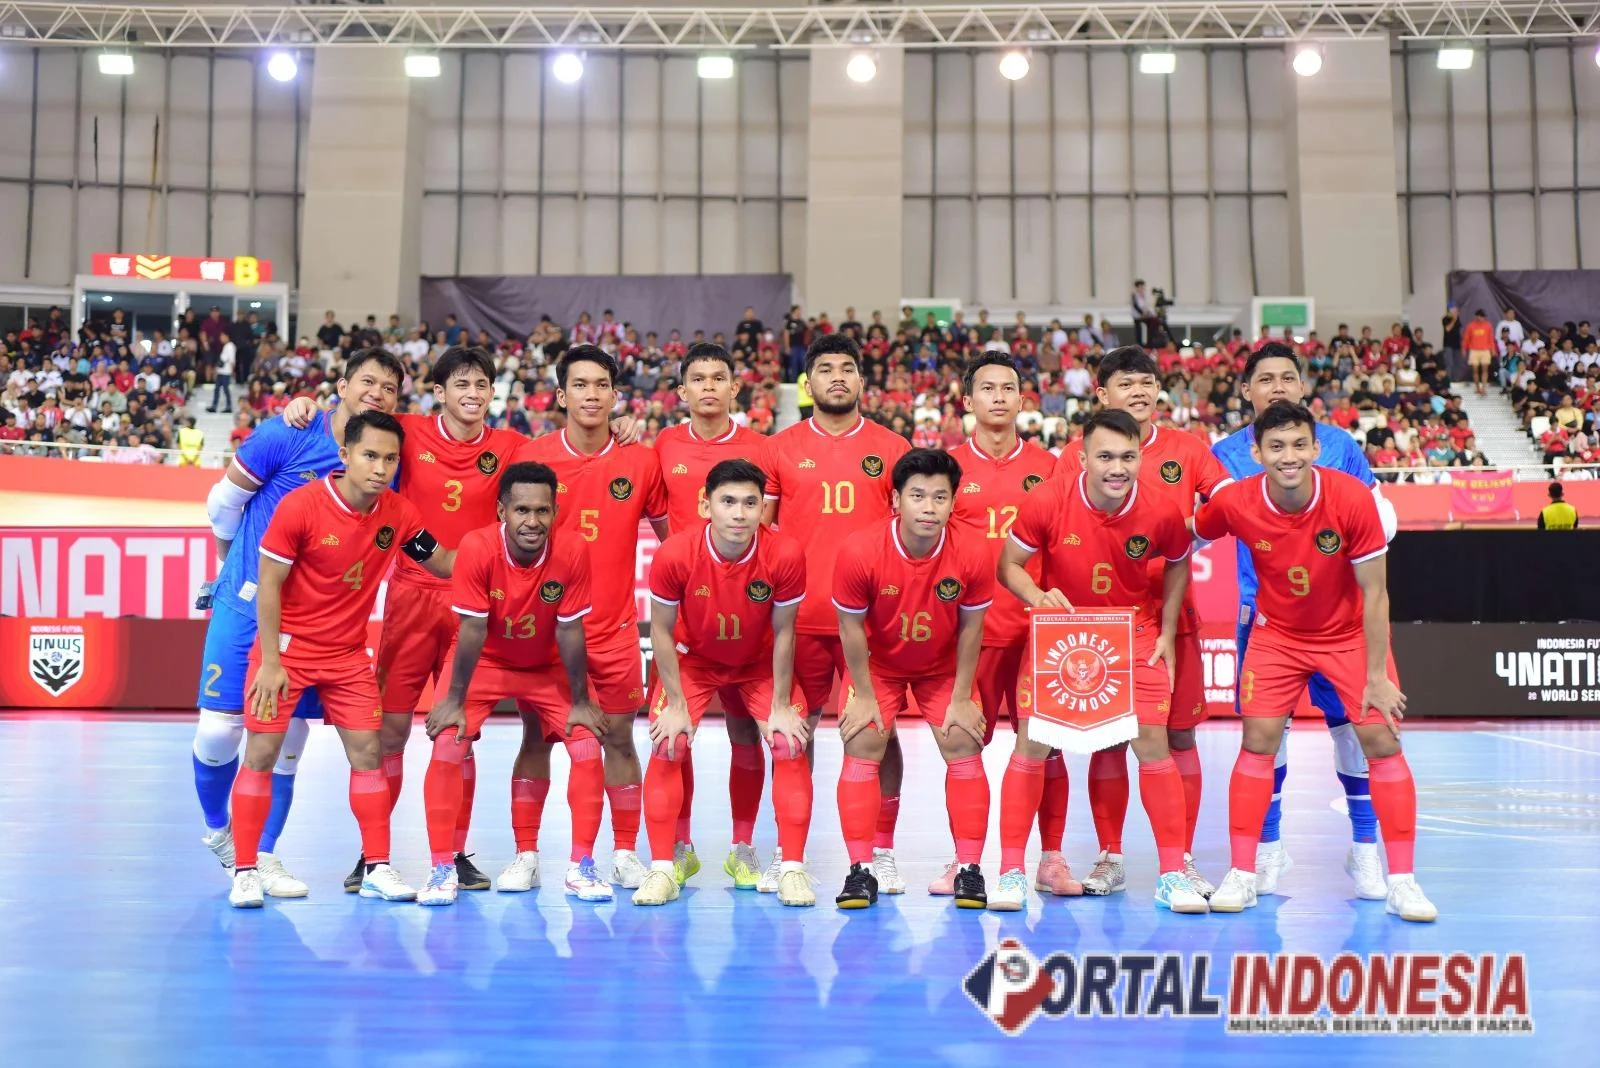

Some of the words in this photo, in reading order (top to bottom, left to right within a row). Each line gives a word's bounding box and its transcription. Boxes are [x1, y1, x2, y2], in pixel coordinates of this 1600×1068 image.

[234, 256, 259, 286] B
[441, 479, 463, 512] 3
[821, 481, 855, 514] 10
[580, 509, 599, 542] 5
[986, 505, 1018, 539] 12
[0, 537, 223, 619] NATI
[342, 559, 364, 590] 4
[1091, 562, 1113, 595] 6
[1287, 565, 1310, 597] 9
[502, 614, 536, 640] 13
[715, 612, 742, 641] 11
[899, 611, 932, 642] 16
[1044, 632, 1121, 666] INDONESIA
[1537, 638, 1585, 649] INDONESIA
[203, 663, 222, 697] 2
[1495, 651, 1600, 686] 4NATI
[1046, 678, 1122, 712] INDONESIA
[1541, 689, 1579, 702] WORLD
